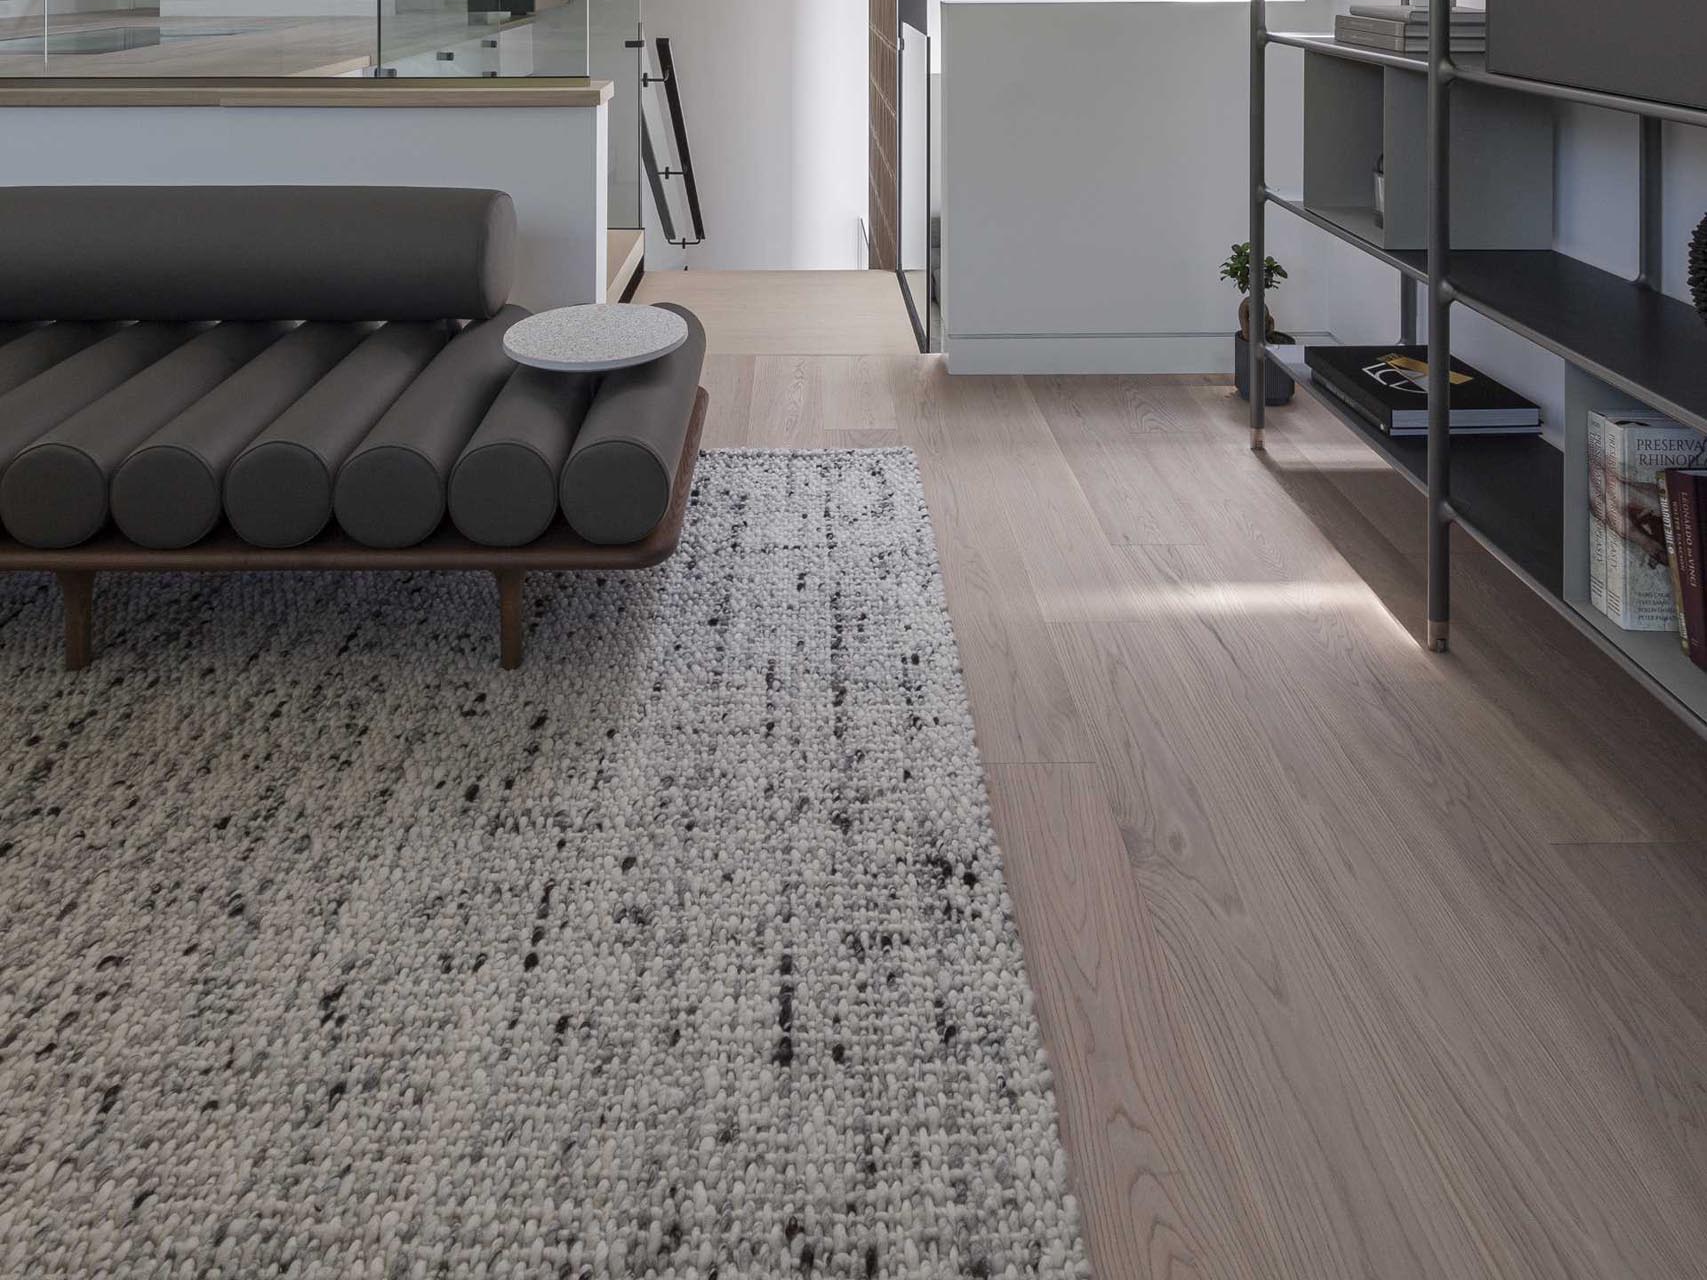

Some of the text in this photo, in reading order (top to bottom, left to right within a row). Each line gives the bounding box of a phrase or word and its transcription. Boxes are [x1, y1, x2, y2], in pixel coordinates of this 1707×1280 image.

[1660, 497, 1674, 548] THE LOUVRE
[1682, 492, 1693, 546] LEONARDO
[1688, 557, 1697, 588] VINCI
